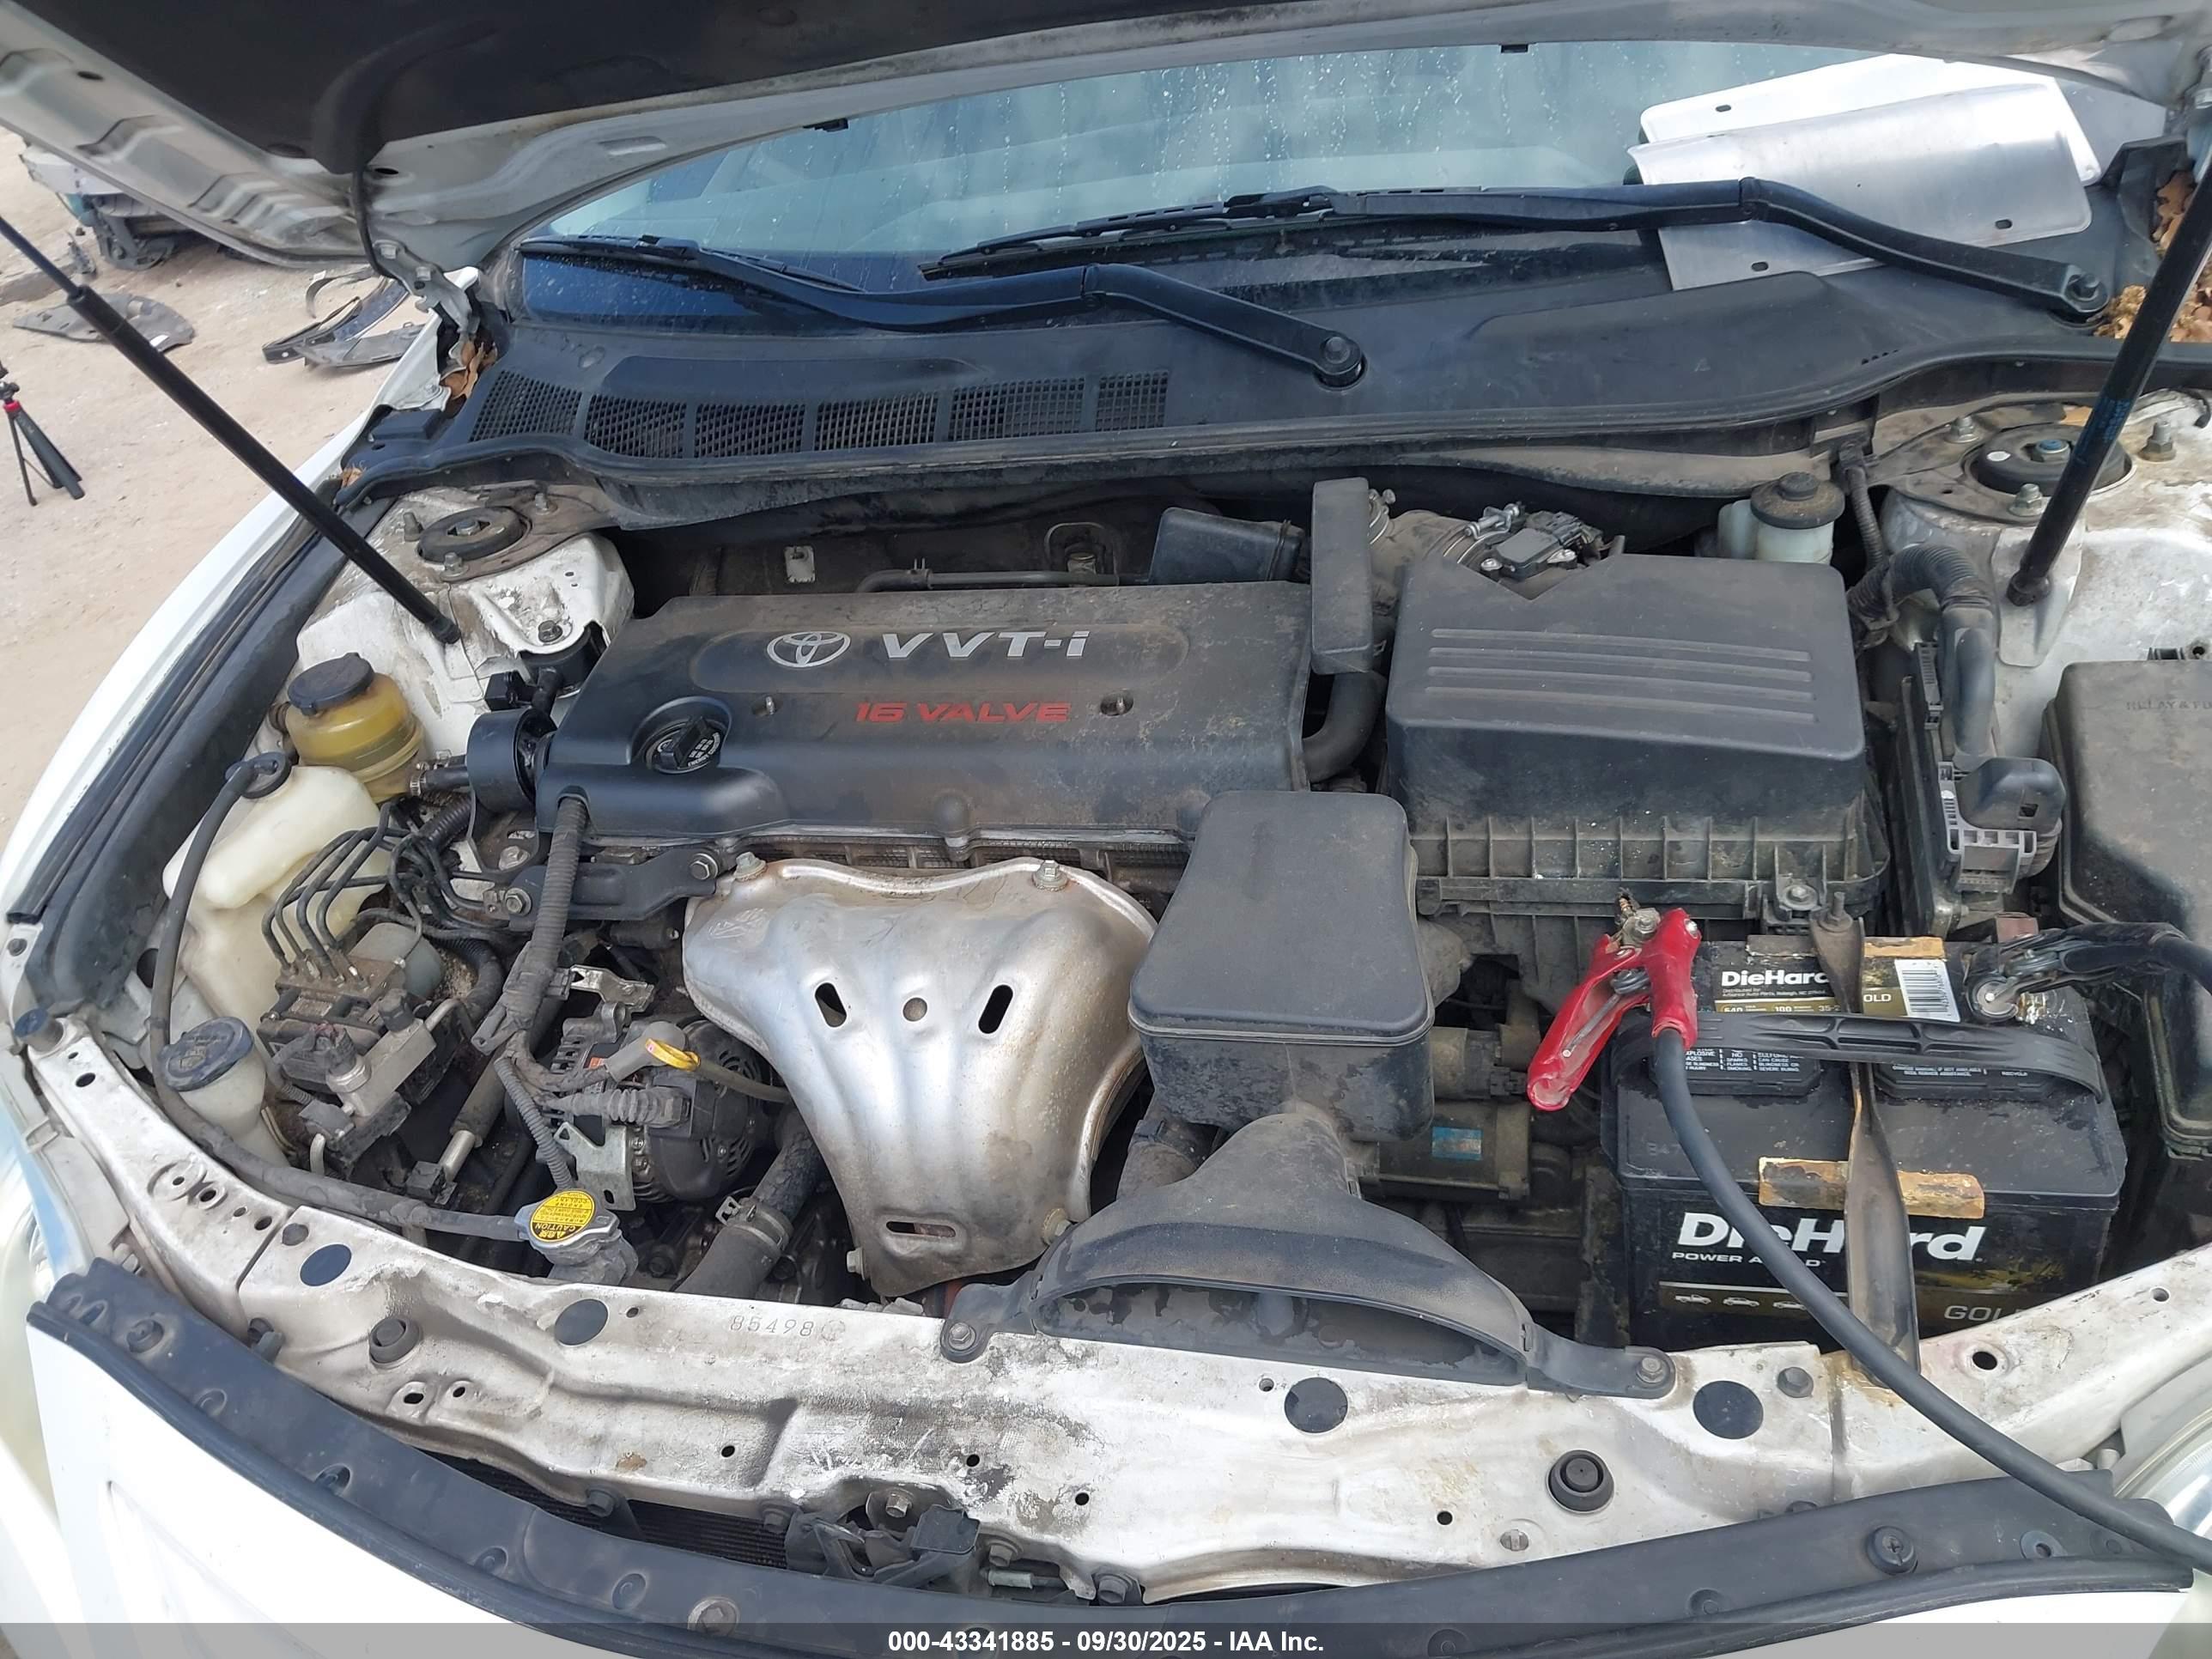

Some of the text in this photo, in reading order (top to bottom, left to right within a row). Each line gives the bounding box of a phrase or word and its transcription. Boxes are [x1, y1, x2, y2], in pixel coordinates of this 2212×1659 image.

[883, 631, 1090, 658] VVT-i
[855, 702, 1071, 722] 16 VALVE
[1863, 994, 1892, 1002] OLD
[535, 1223, 576, 1232] CAUTION
[1677, 1212, 1986, 1261] DHrd
[1672, 1251, 1743, 1263] POWER
[1943, 1304, 2022, 1322] GOL
[730, 1315, 815, 1337] 85498
